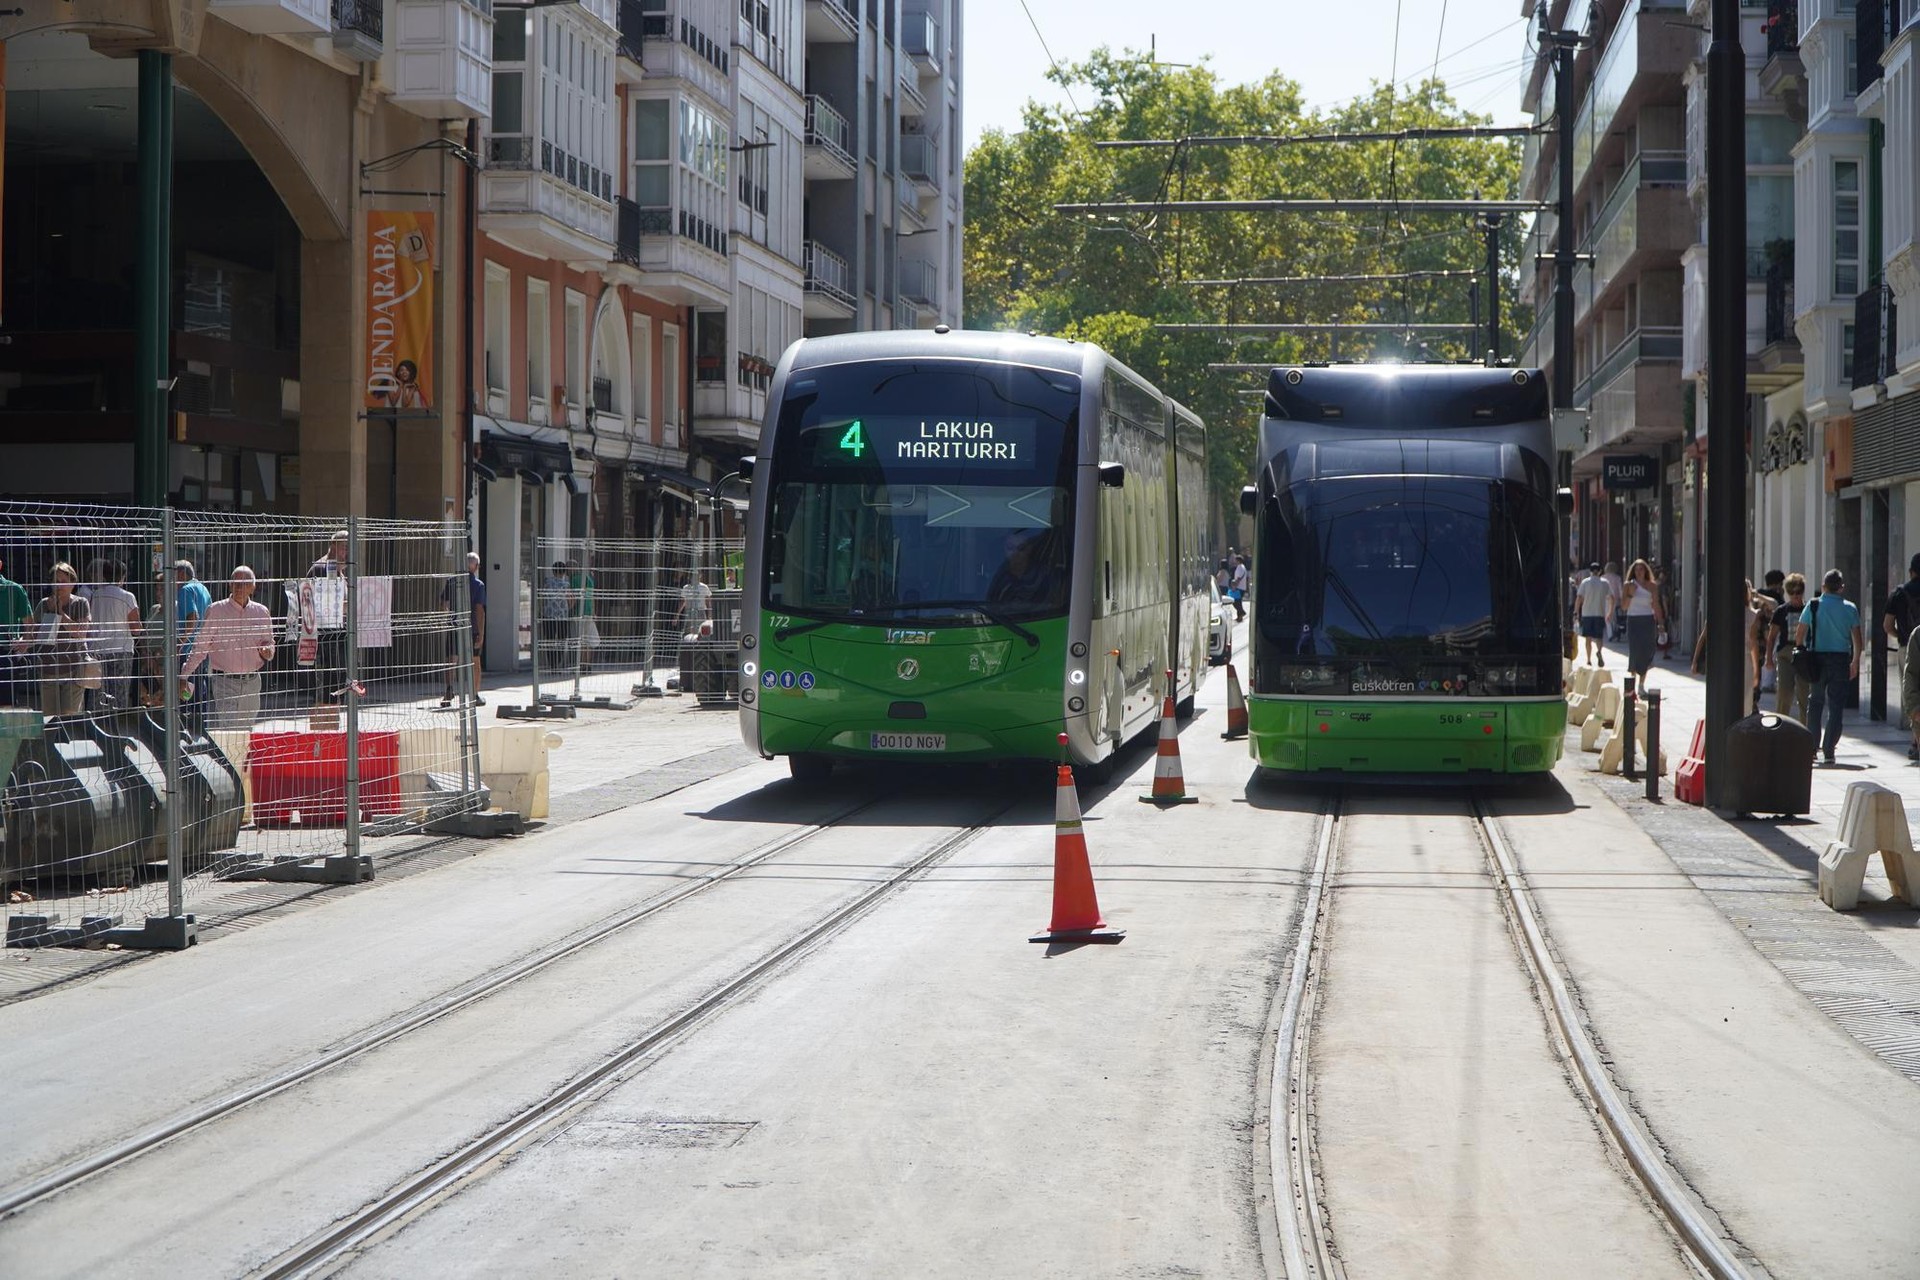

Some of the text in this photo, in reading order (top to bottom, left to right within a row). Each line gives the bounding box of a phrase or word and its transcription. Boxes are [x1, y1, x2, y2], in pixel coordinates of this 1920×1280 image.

[368, 226, 421, 393] DENDARABA
[921, 422, 993, 438] LAKUA
[840, 420, 864, 457] 4
[898, 442, 1017, 459] MARITURRI
[1608, 465, 1645, 477] PLURI
[769, 616, 790, 627] 172
[1440, 714, 1463, 724] 508
[880, 735, 941, 748] 0010 NGV
